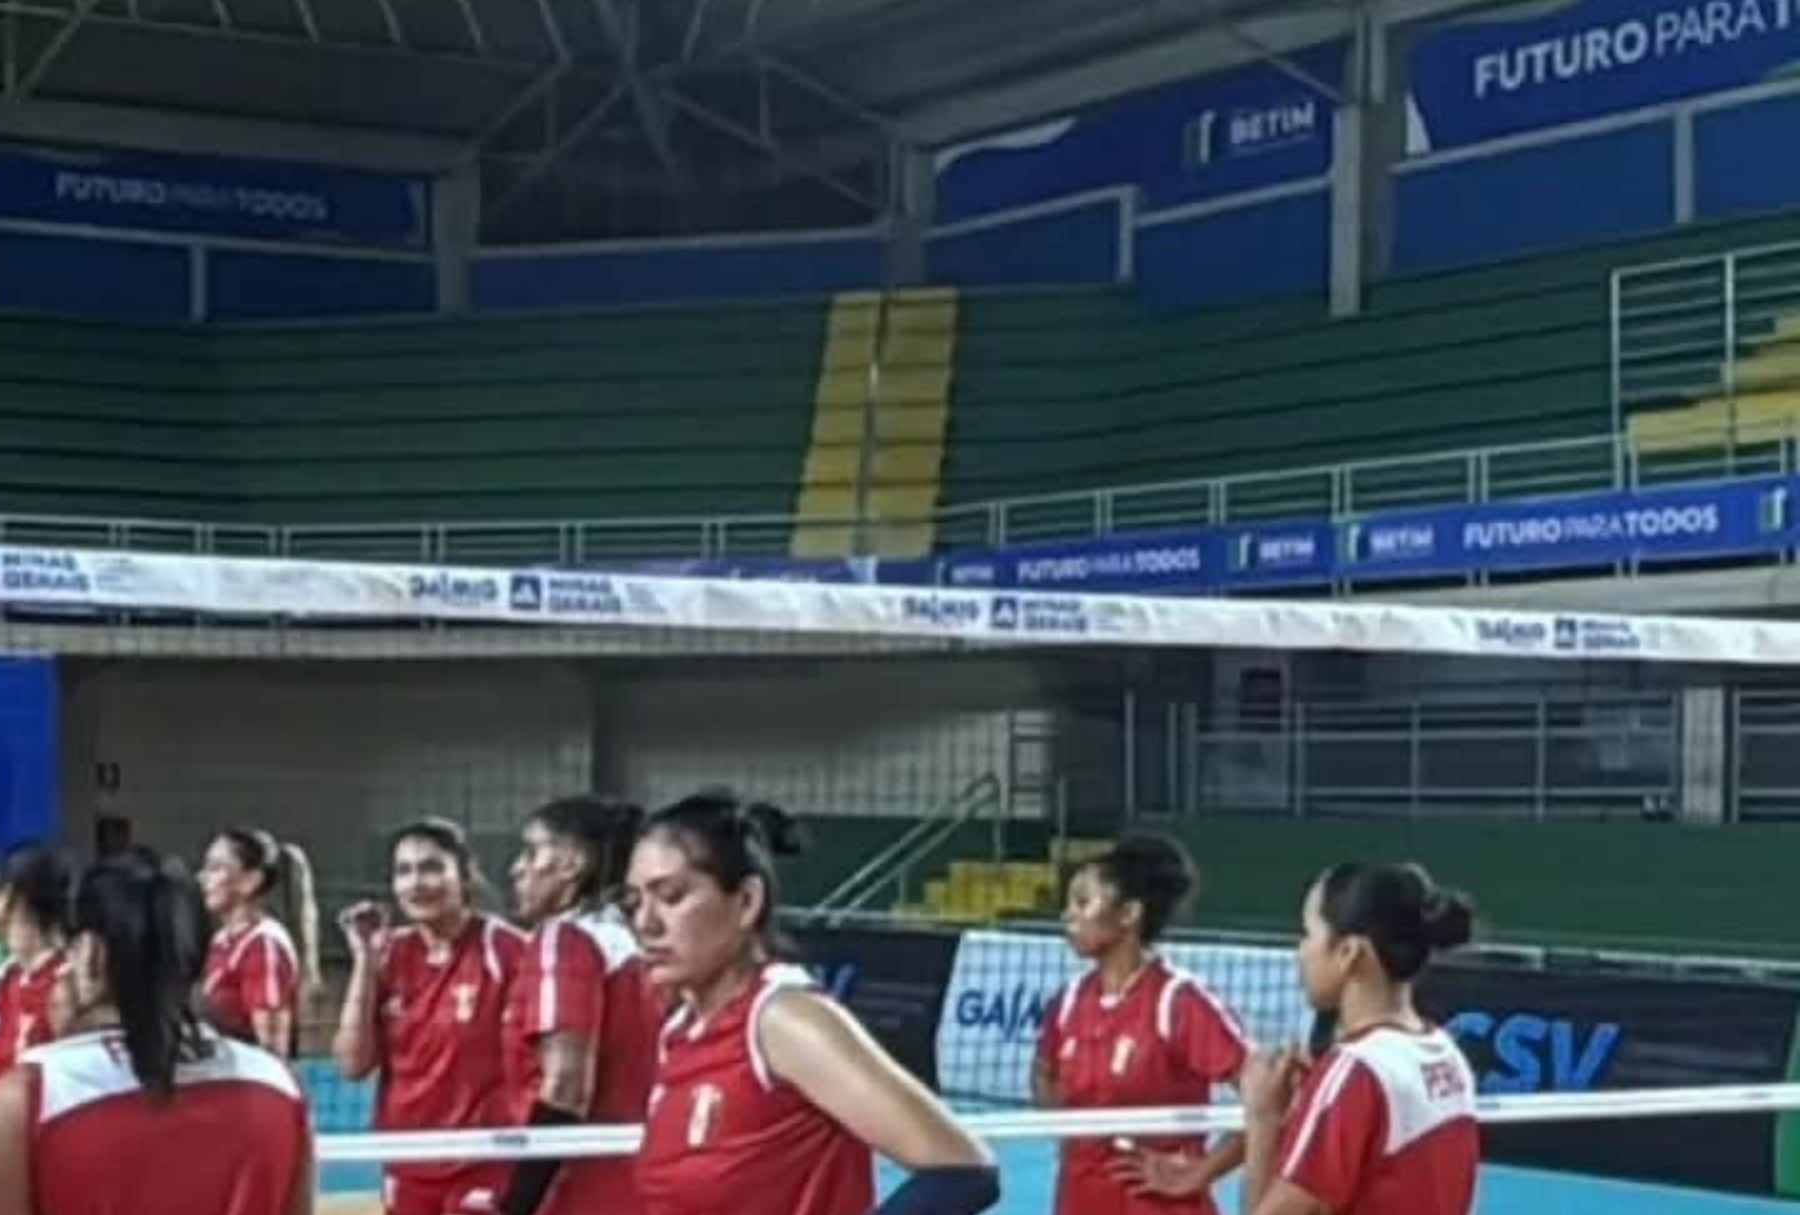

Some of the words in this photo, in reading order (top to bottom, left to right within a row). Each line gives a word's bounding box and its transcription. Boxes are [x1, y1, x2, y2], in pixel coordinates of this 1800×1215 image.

[1474, 20, 1651, 98] FUTURO
[1654, 0, 1767, 56] PARA
[1774, 0, 1800, 29] T
[1230, 102, 1315, 143] BETIM
[1463, 520, 1562, 550] FUTURO
[1625, 502, 1720, 537] TODOS
[1017, 557, 1089, 580] FUTURO
[1134, 545, 1200, 573] TODOS
